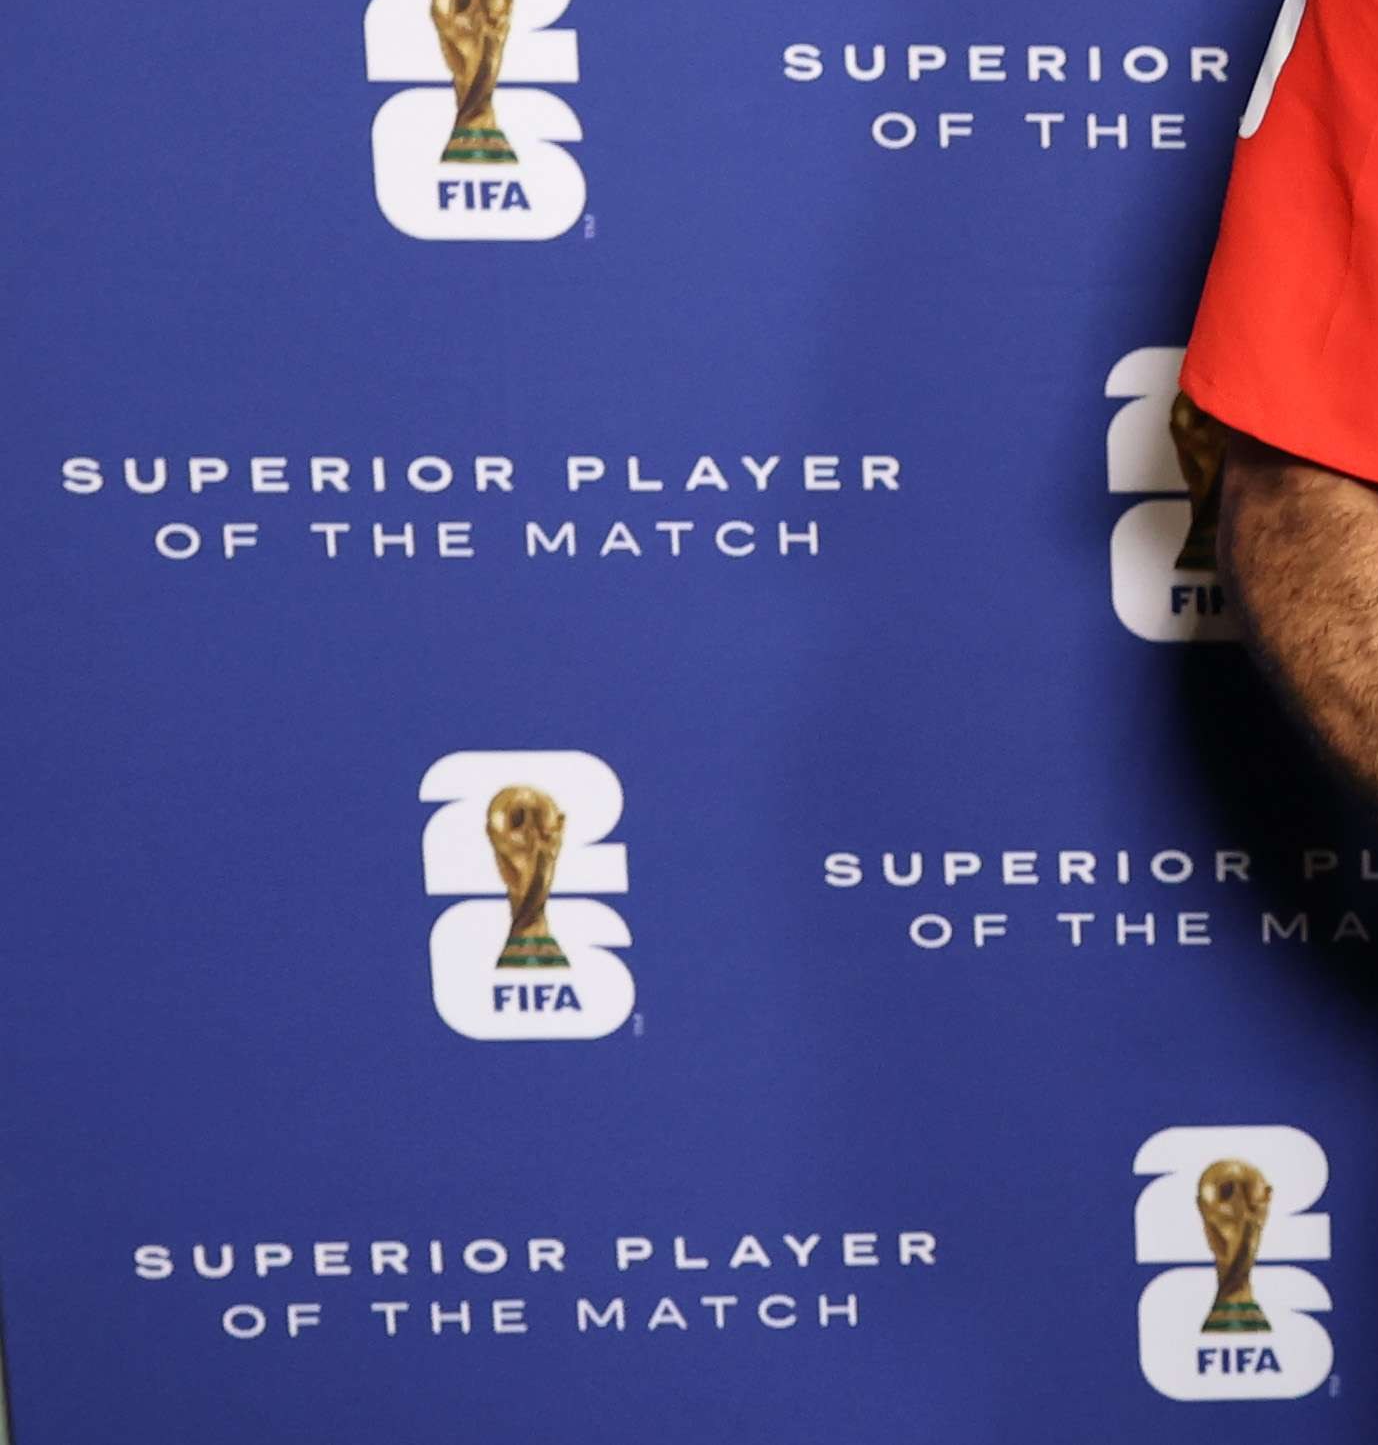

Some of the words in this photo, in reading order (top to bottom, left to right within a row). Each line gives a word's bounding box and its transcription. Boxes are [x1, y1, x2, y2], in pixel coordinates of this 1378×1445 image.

[783, 44, 1228, 83] SUPERIOR
[872, 112, 974, 149] OF
[1024, 113, 1186, 149] THE
[438, 181, 529, 209] FIFA
[62, 456, 514, 494] SUPERIOR
[567, 456, 899, 491] PLAYER
[155, 523, 258, 559] OF
[310, 522, 474, 558] THE
[526, 520, 818, 557] MATCH
[824, 850, 1249, 887] SUPERIOR
[909, 914, 1008, 949] OF
[1056, 913, 1211, 946] THE
[494, 985, 582, 1012] FIFA
[134, 1238, 565, 1279] SUPERIOR
[616, 1231, 936, 1271] PLAYER
[223, 1303, 321, 1339] OF
[371, 1299, 528, 1336] THE
[577, 1294, 857, 1331] MATCH
[1198, 1347, 1281, 1373] FIFA
